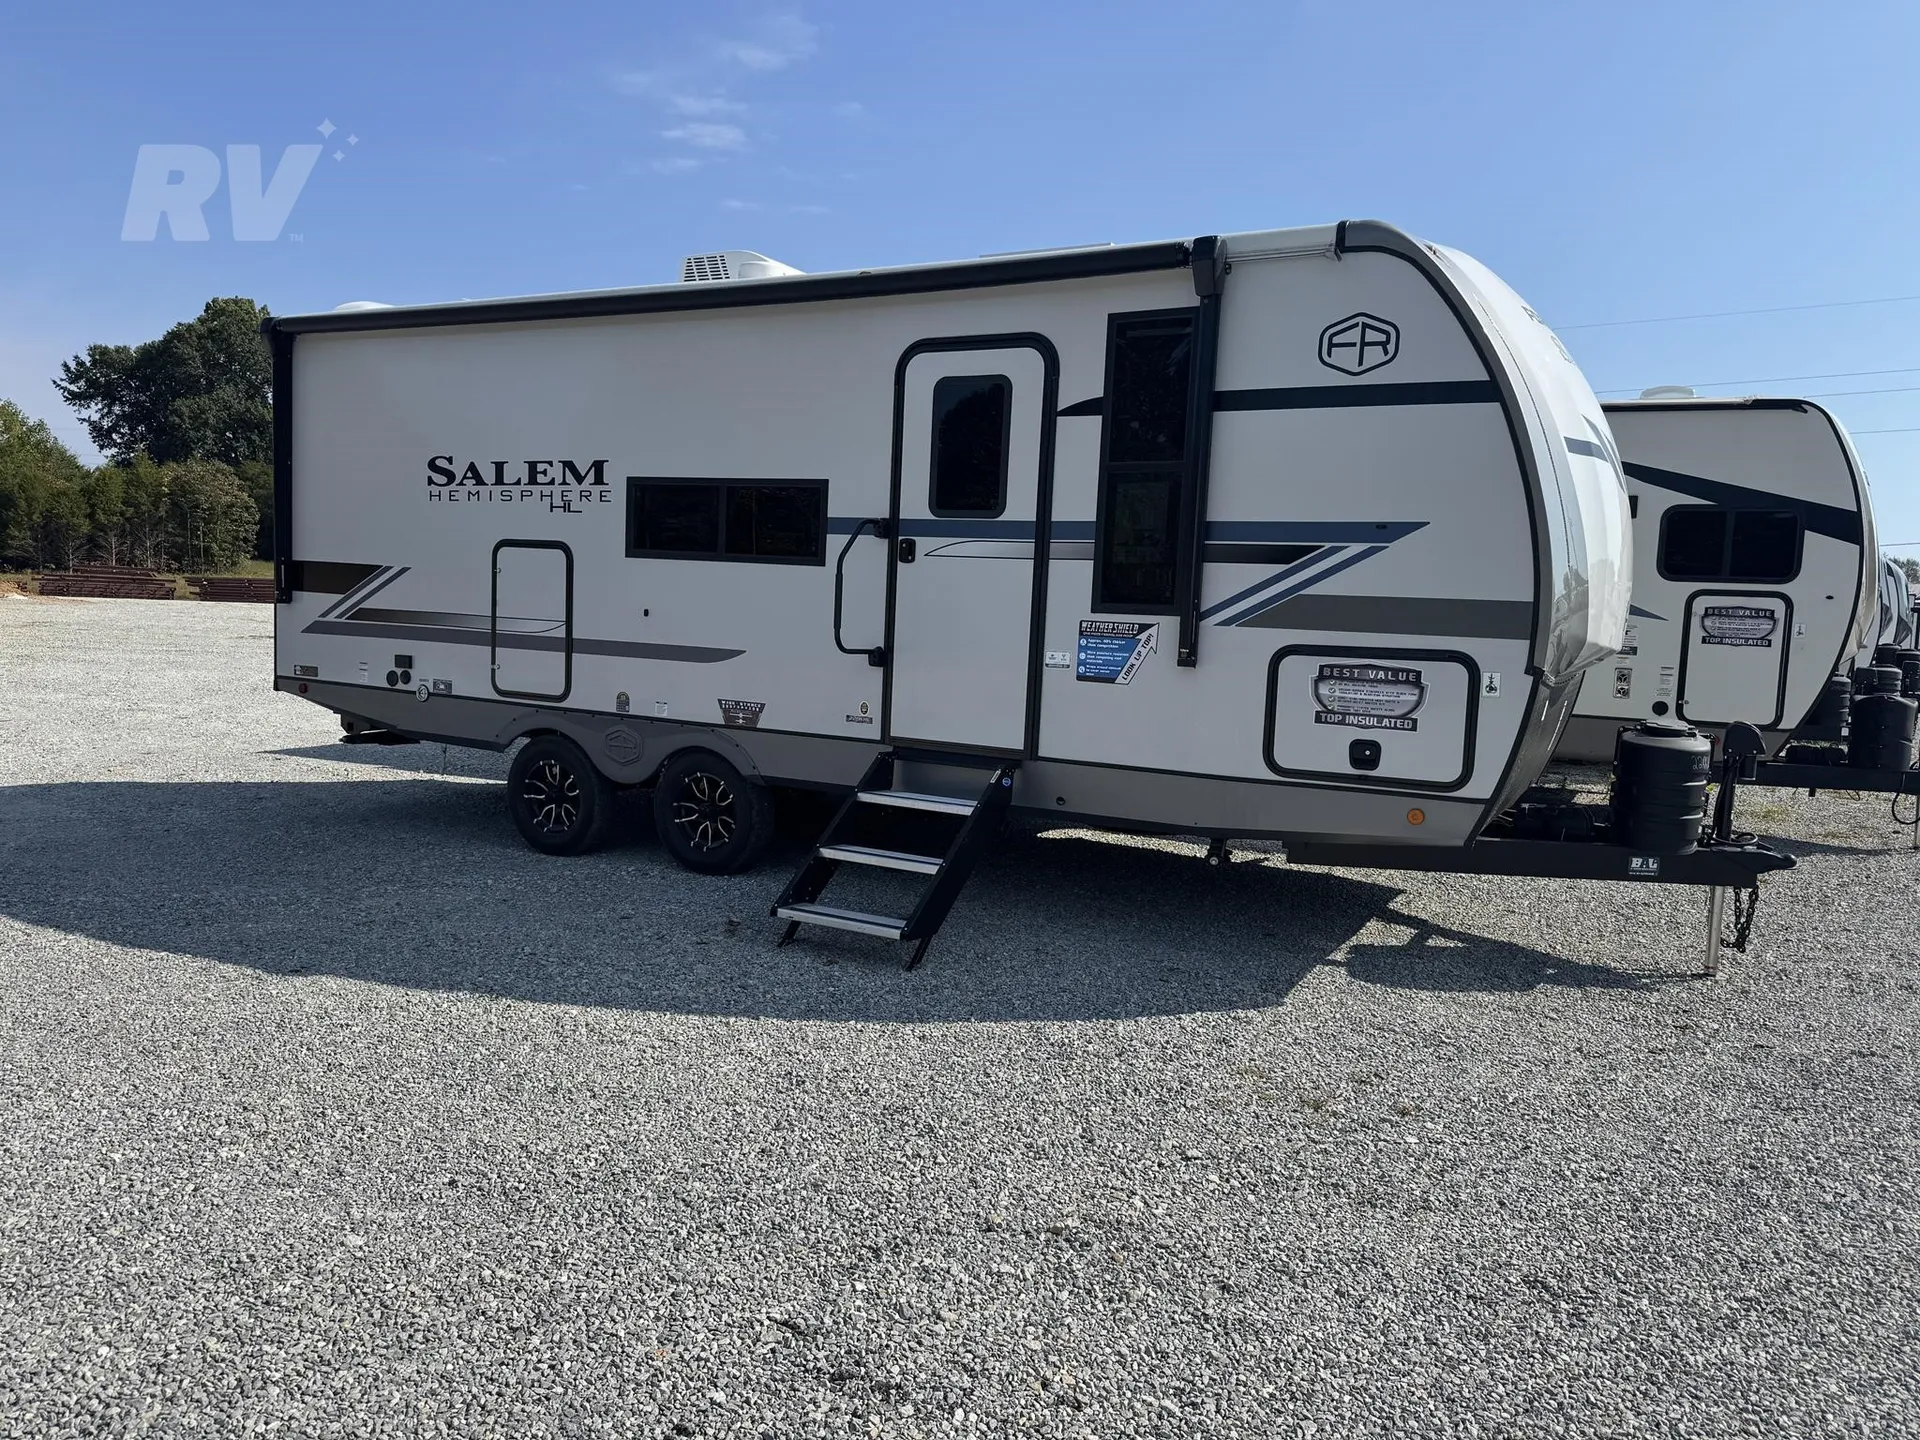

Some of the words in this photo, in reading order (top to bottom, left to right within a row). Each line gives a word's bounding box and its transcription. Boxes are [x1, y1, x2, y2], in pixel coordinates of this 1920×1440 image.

[1327, 321, 1391, 367] FR
[427, 456, 609, 487] SALEM
[429, 490, 612, 502] HEMISPHERE
[550, 502, 582, 513] HL
[1739, 609, 1772, 617] VALUE
[1722, 638, 1769, 646] INSULATED
[1323, 668, 1360, 678] BEST
[1368, 670, 1416, 681] VALUE
[1320, 713, 1342, 723] TOP
[1346, 714, 1413, 729] INSULATED
